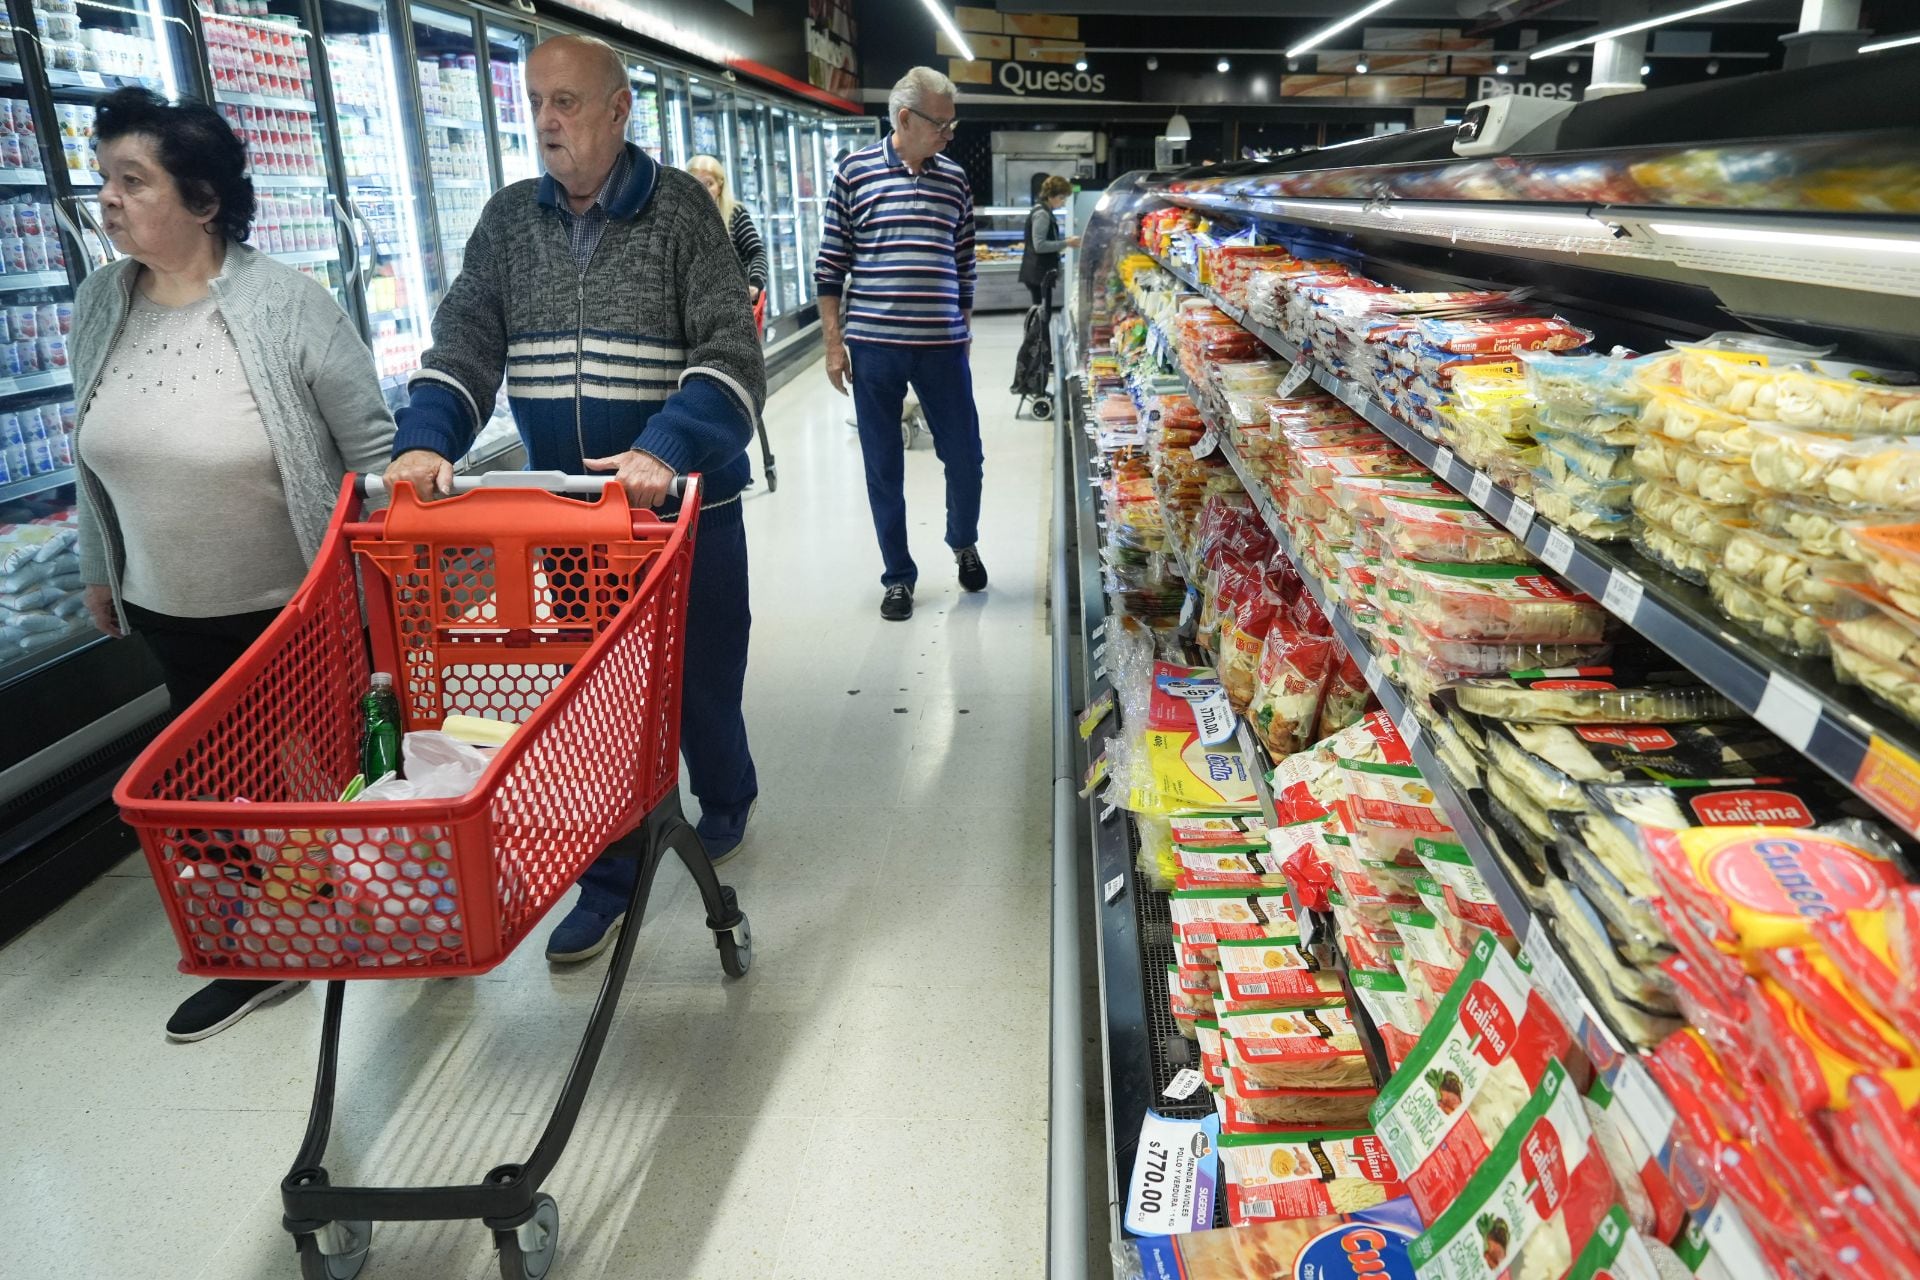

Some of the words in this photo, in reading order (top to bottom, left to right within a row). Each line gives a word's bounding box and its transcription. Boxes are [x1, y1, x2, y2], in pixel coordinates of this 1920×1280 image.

[1000, 62, 1105, 95] Quesos
[1477, 77, 1573, 100] Panes
[1703, 806, 1801, 822] Italiana
[1735, 797, 1752, 806] la
[1466, 993, 1506, 1056] Italiana
[1490, 1002, 1500, 1019] la
[1413, 1086, 1439, 1126] CARNE
[1401, 1095, 1436, 1151] ESPINACA
[1176, 1147, 1185, 1168] POLLO
[1186, 1157, 1195, 1183] MENDIA
[1362, 1138, 1383, 1178] Italiana
[1527, 1131, 1559, 1209] Italiana
[1171, 1175, 1181, 1207] VERDURA
[1182, 1184, 1192, 1217] RAVIOLES
[1197, 1187, 1209, 1225] SUGERIDO
